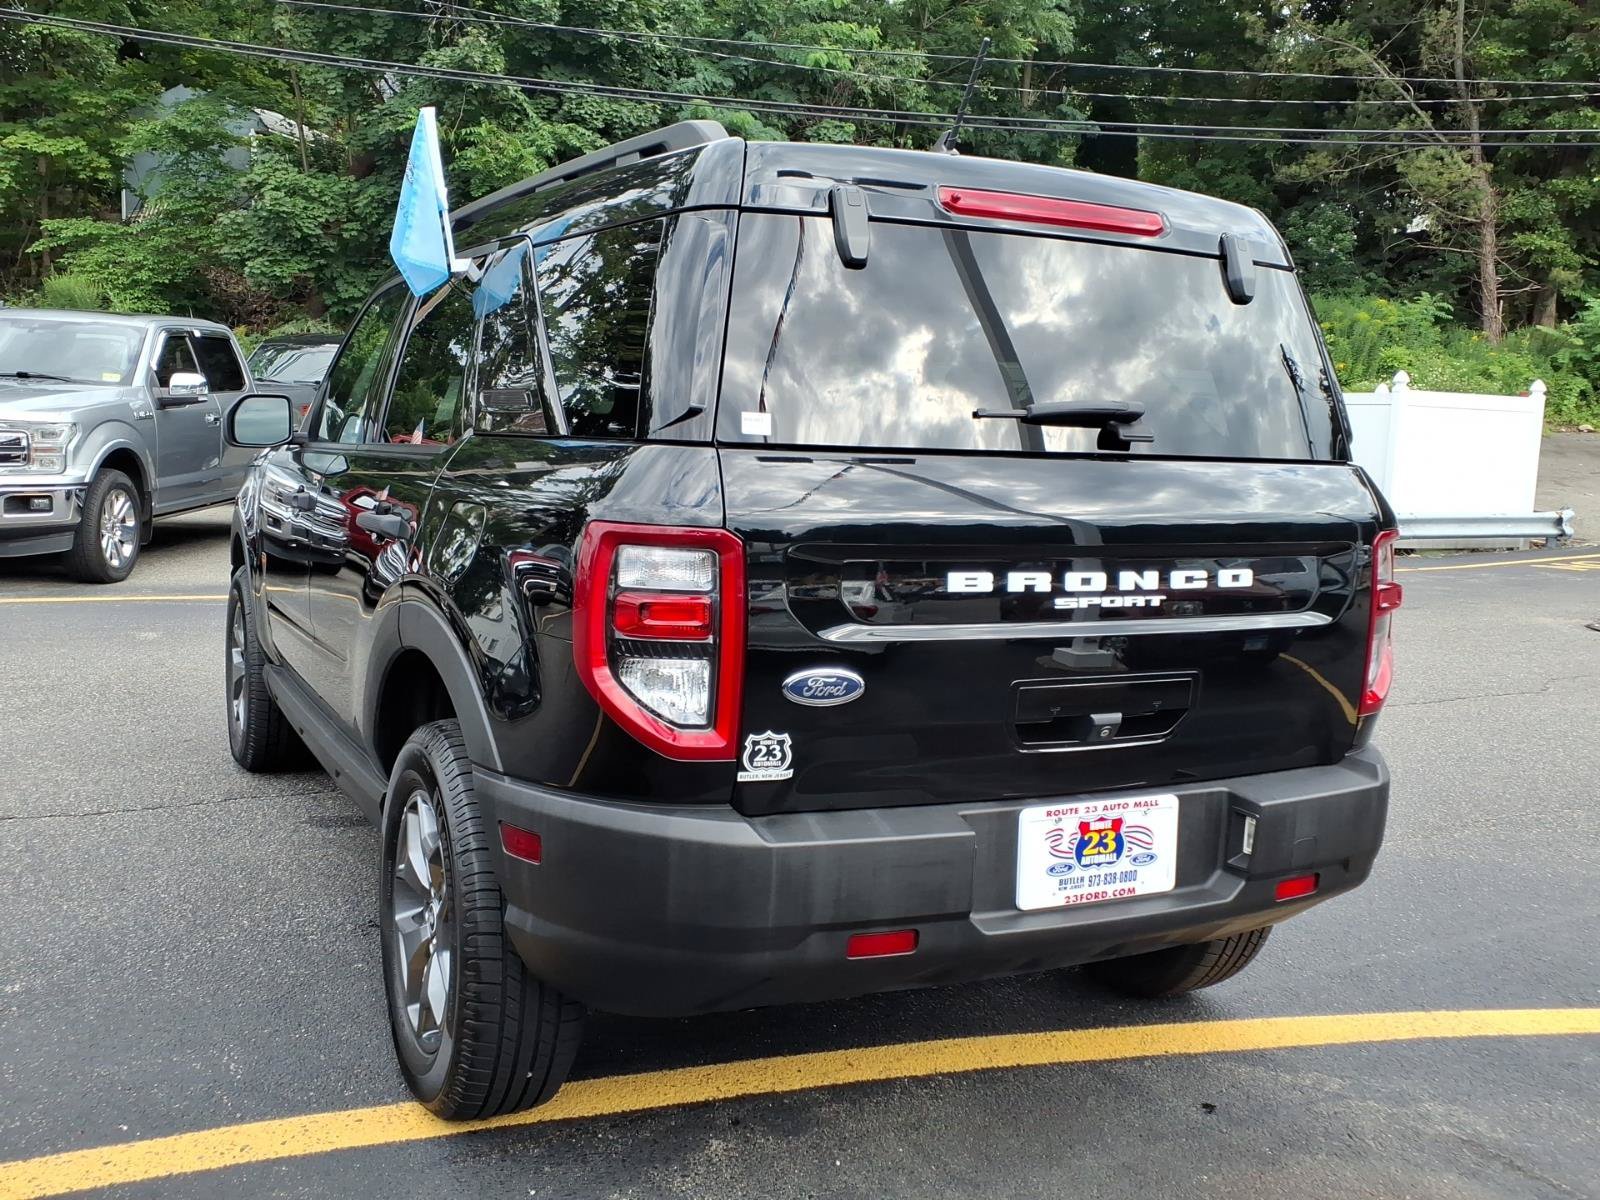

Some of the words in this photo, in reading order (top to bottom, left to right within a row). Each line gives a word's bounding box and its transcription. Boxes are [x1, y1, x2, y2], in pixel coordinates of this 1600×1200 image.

[947, 569, 1253, 593] BRONCO
[1054, 595, 1167, 610] SPORT
[803, 676, 848, 697] Ford
[753, 745, 782, 760] 23
[1046, 807, 1079, 818] ROUTE
[1084, 805, 1098, 814] 23
[1102, 802, 1129, 812] AUTO
[1133, 799, 1159, 808] MALL
[1082, 830, 1117, 855] 23
[1058, 876, 1085, 887] BUTLER
[1088, 870, 1137, 887] 973-838-0800
[1064, 887, 1136, 904] 23FORD.COM
